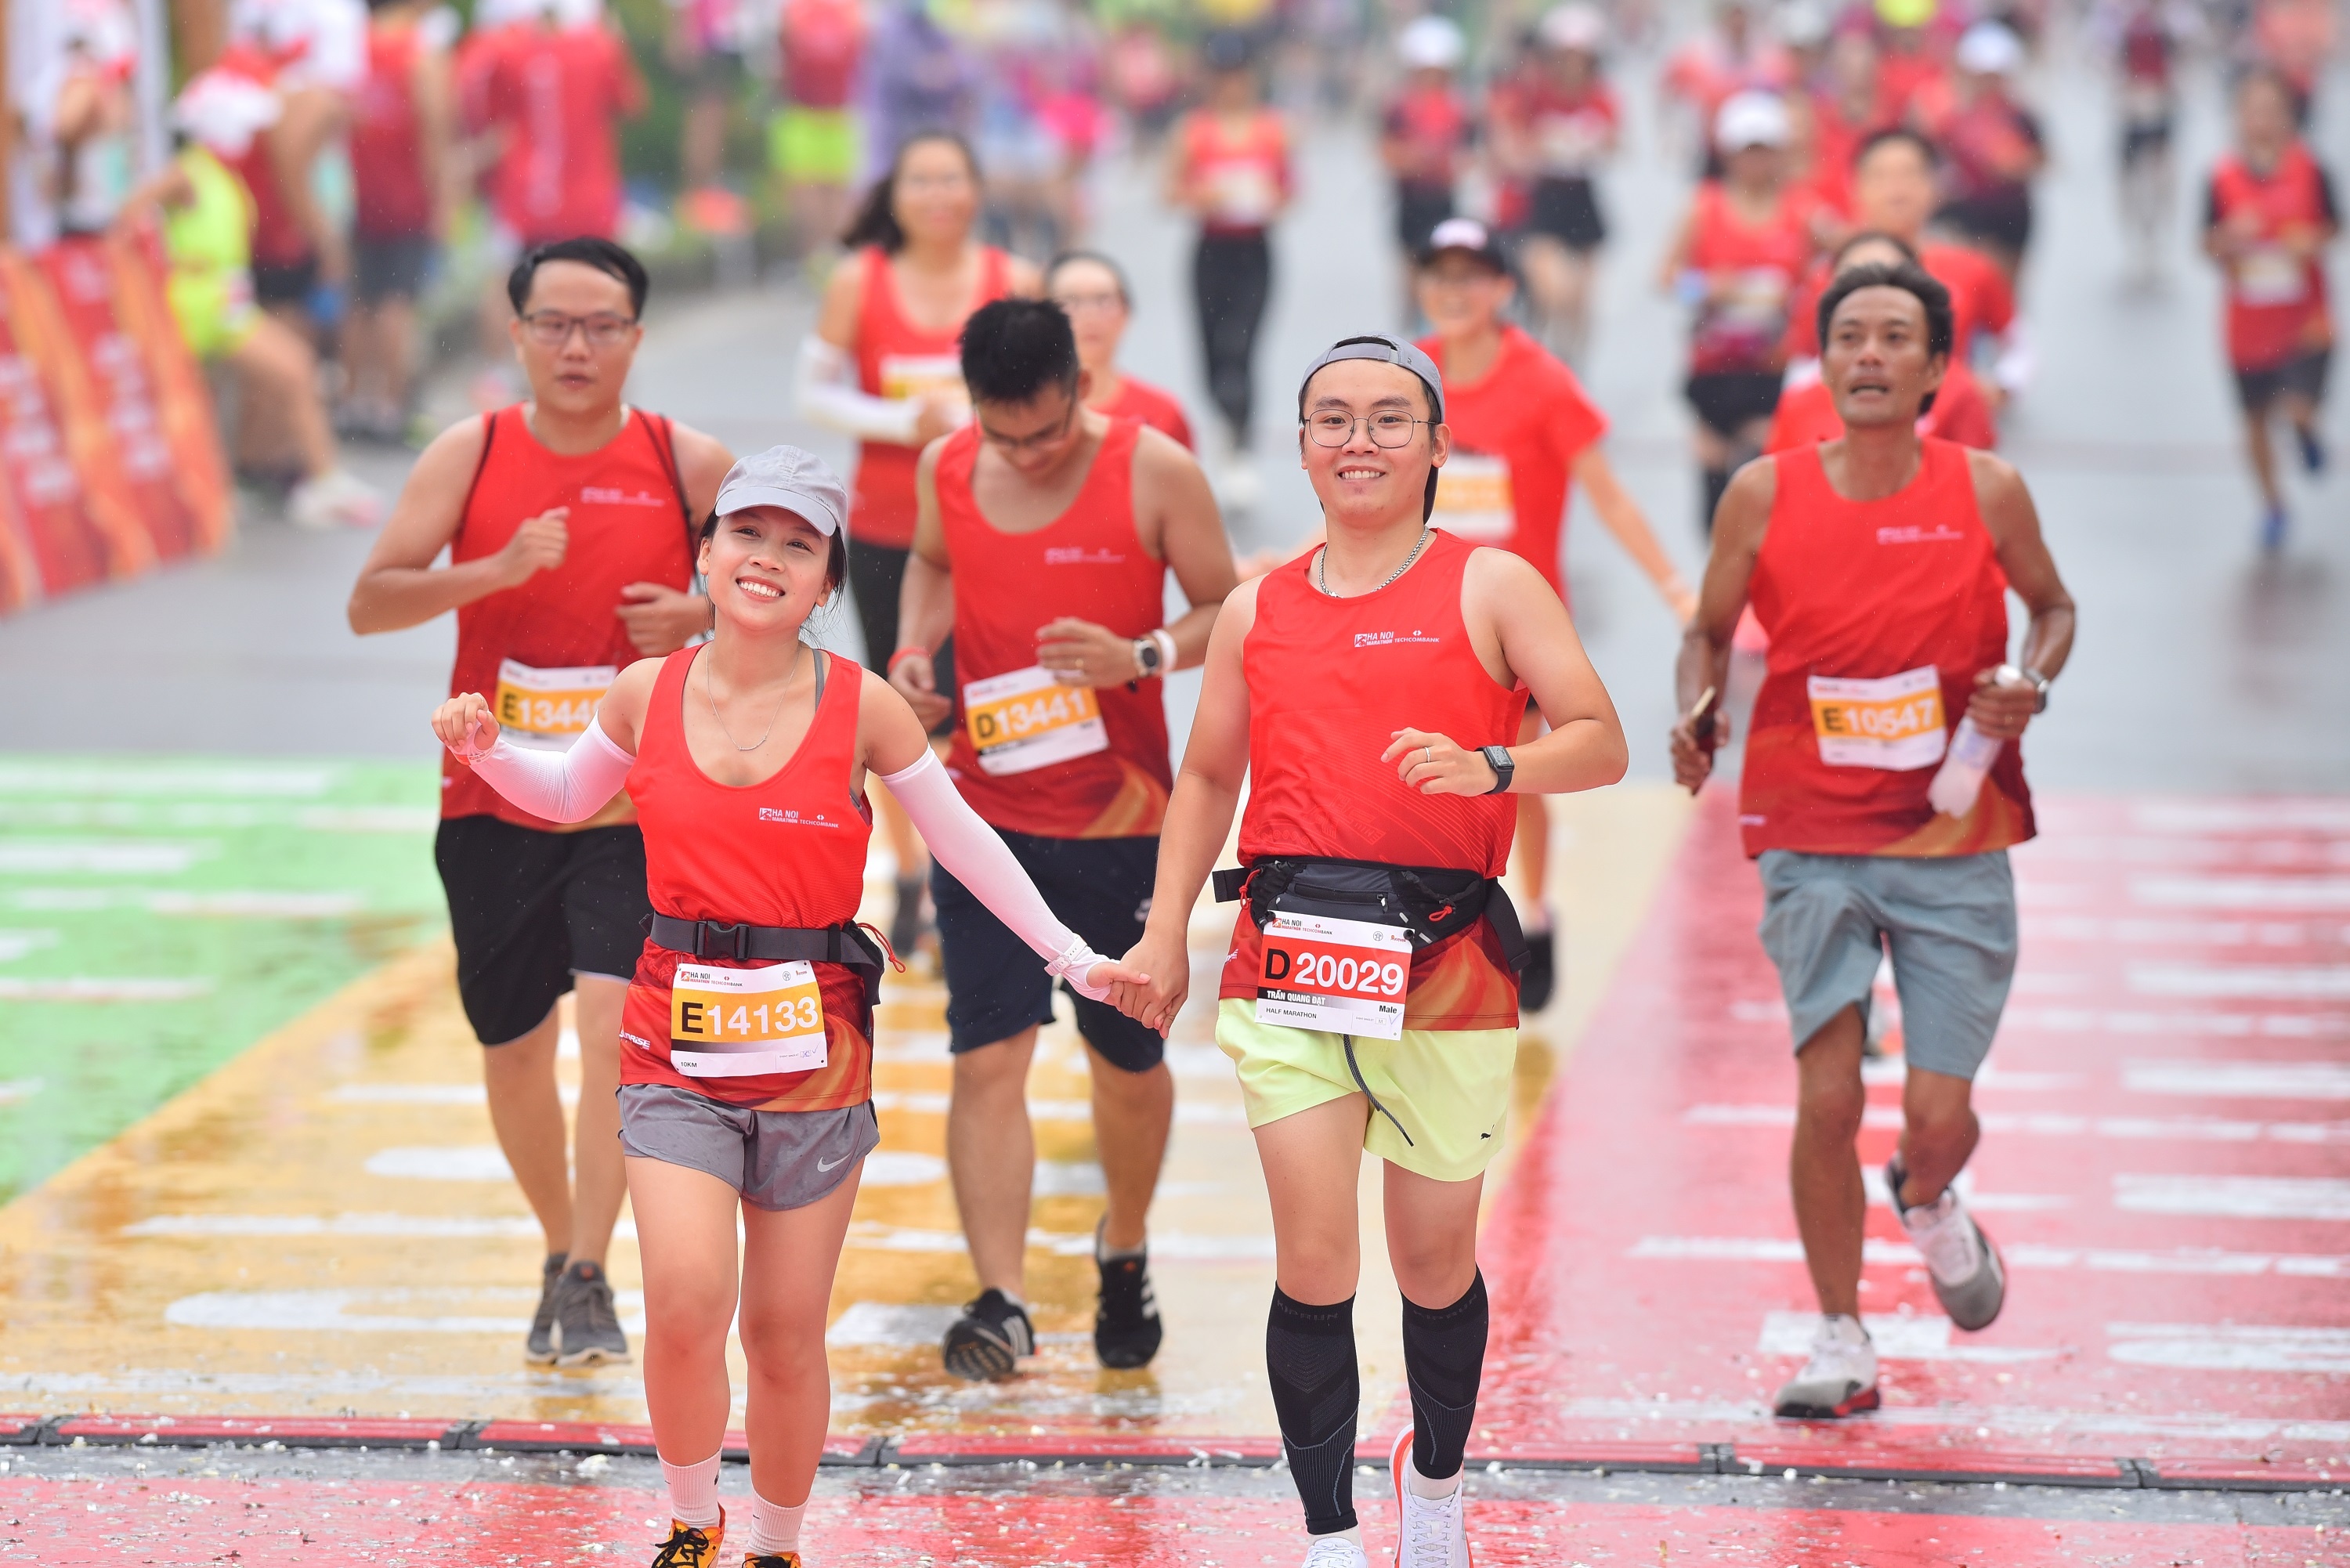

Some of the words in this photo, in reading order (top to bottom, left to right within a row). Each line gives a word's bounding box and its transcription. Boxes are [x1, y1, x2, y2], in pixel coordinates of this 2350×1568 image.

[1367, 632, 1378, 641] HA
[502, 692, 602, 728] E1344
[772, 808, 783, 817] HA
[785, 810, 799, 818] NOI
[800, 819, 839, 828] TECHCOMBANK
[1287, 993, 1311, 1003] QUANG
[1311, 996, 1326, 1006] ĐẠT
[1379, 1005, 1397, 1013] Male
[1283, 1010, 1317, 1019] MARATHON
